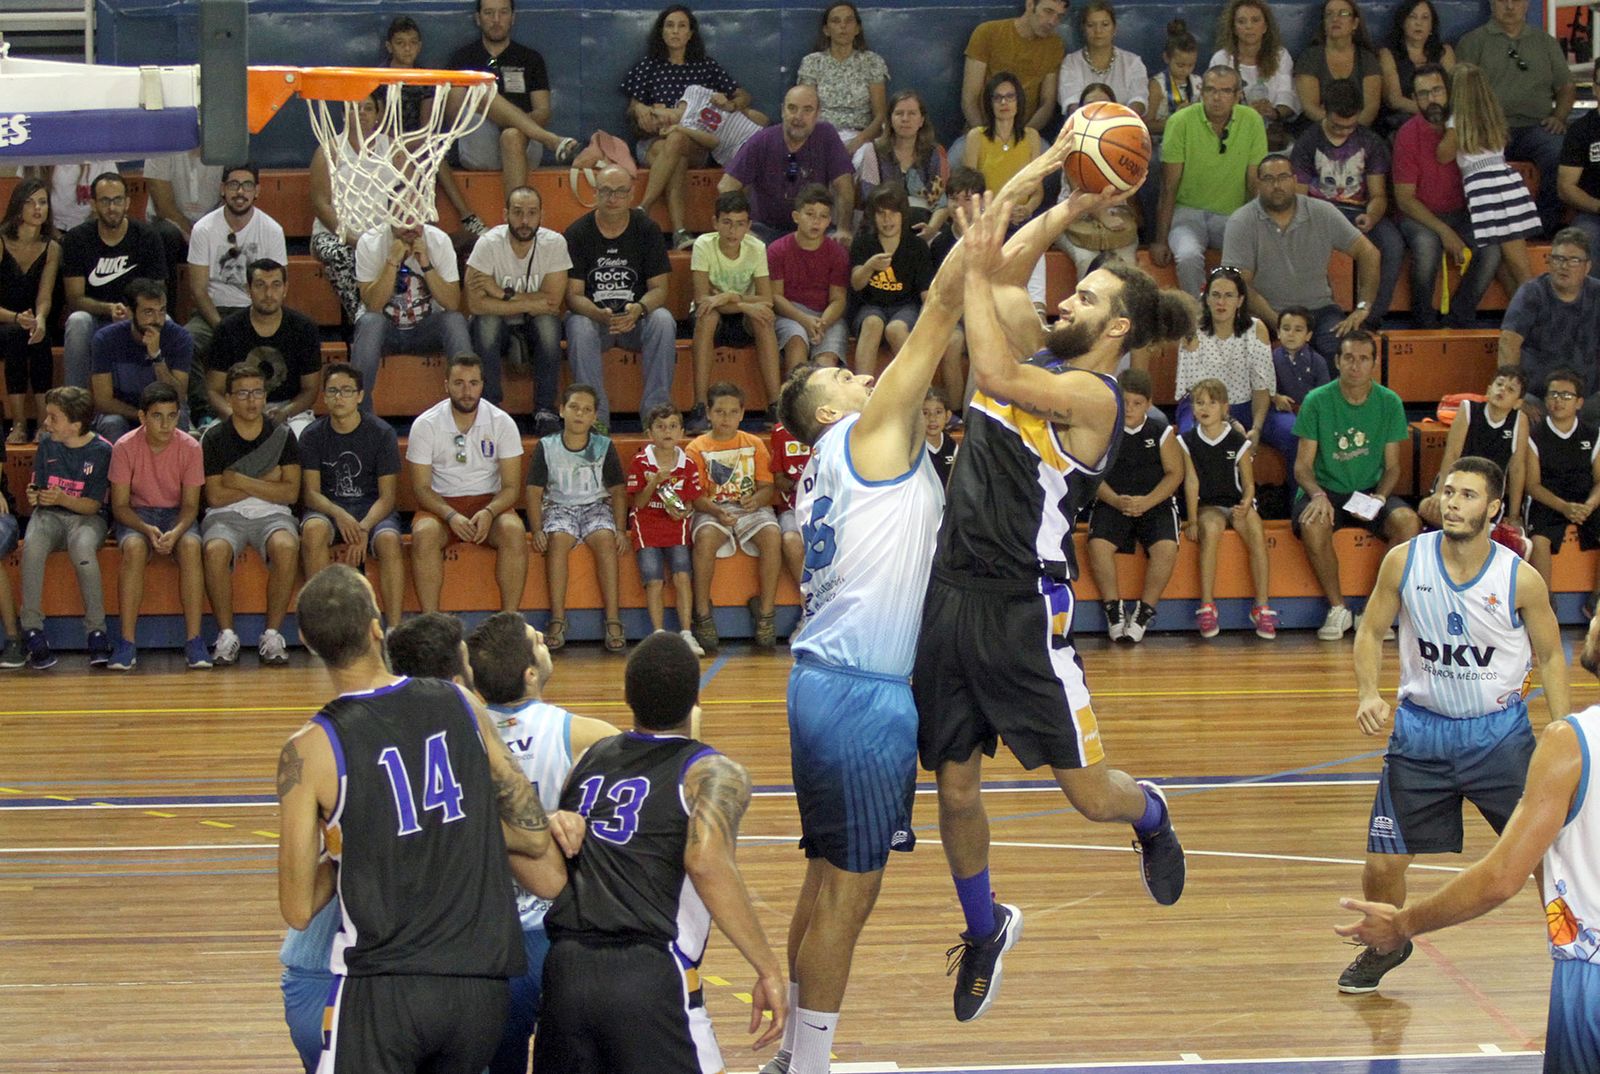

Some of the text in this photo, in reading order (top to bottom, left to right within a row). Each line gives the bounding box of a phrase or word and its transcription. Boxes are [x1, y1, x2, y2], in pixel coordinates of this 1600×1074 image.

[96, 255, 129, 274] NIKE
[594, 271, 631, 282] ROCK
[1447, 611, 1464, 636] 8
[1418, 638, 1497, 668] DKV
[377, 730, 467, 837] 14
[577, 775, 660, 845] 13
